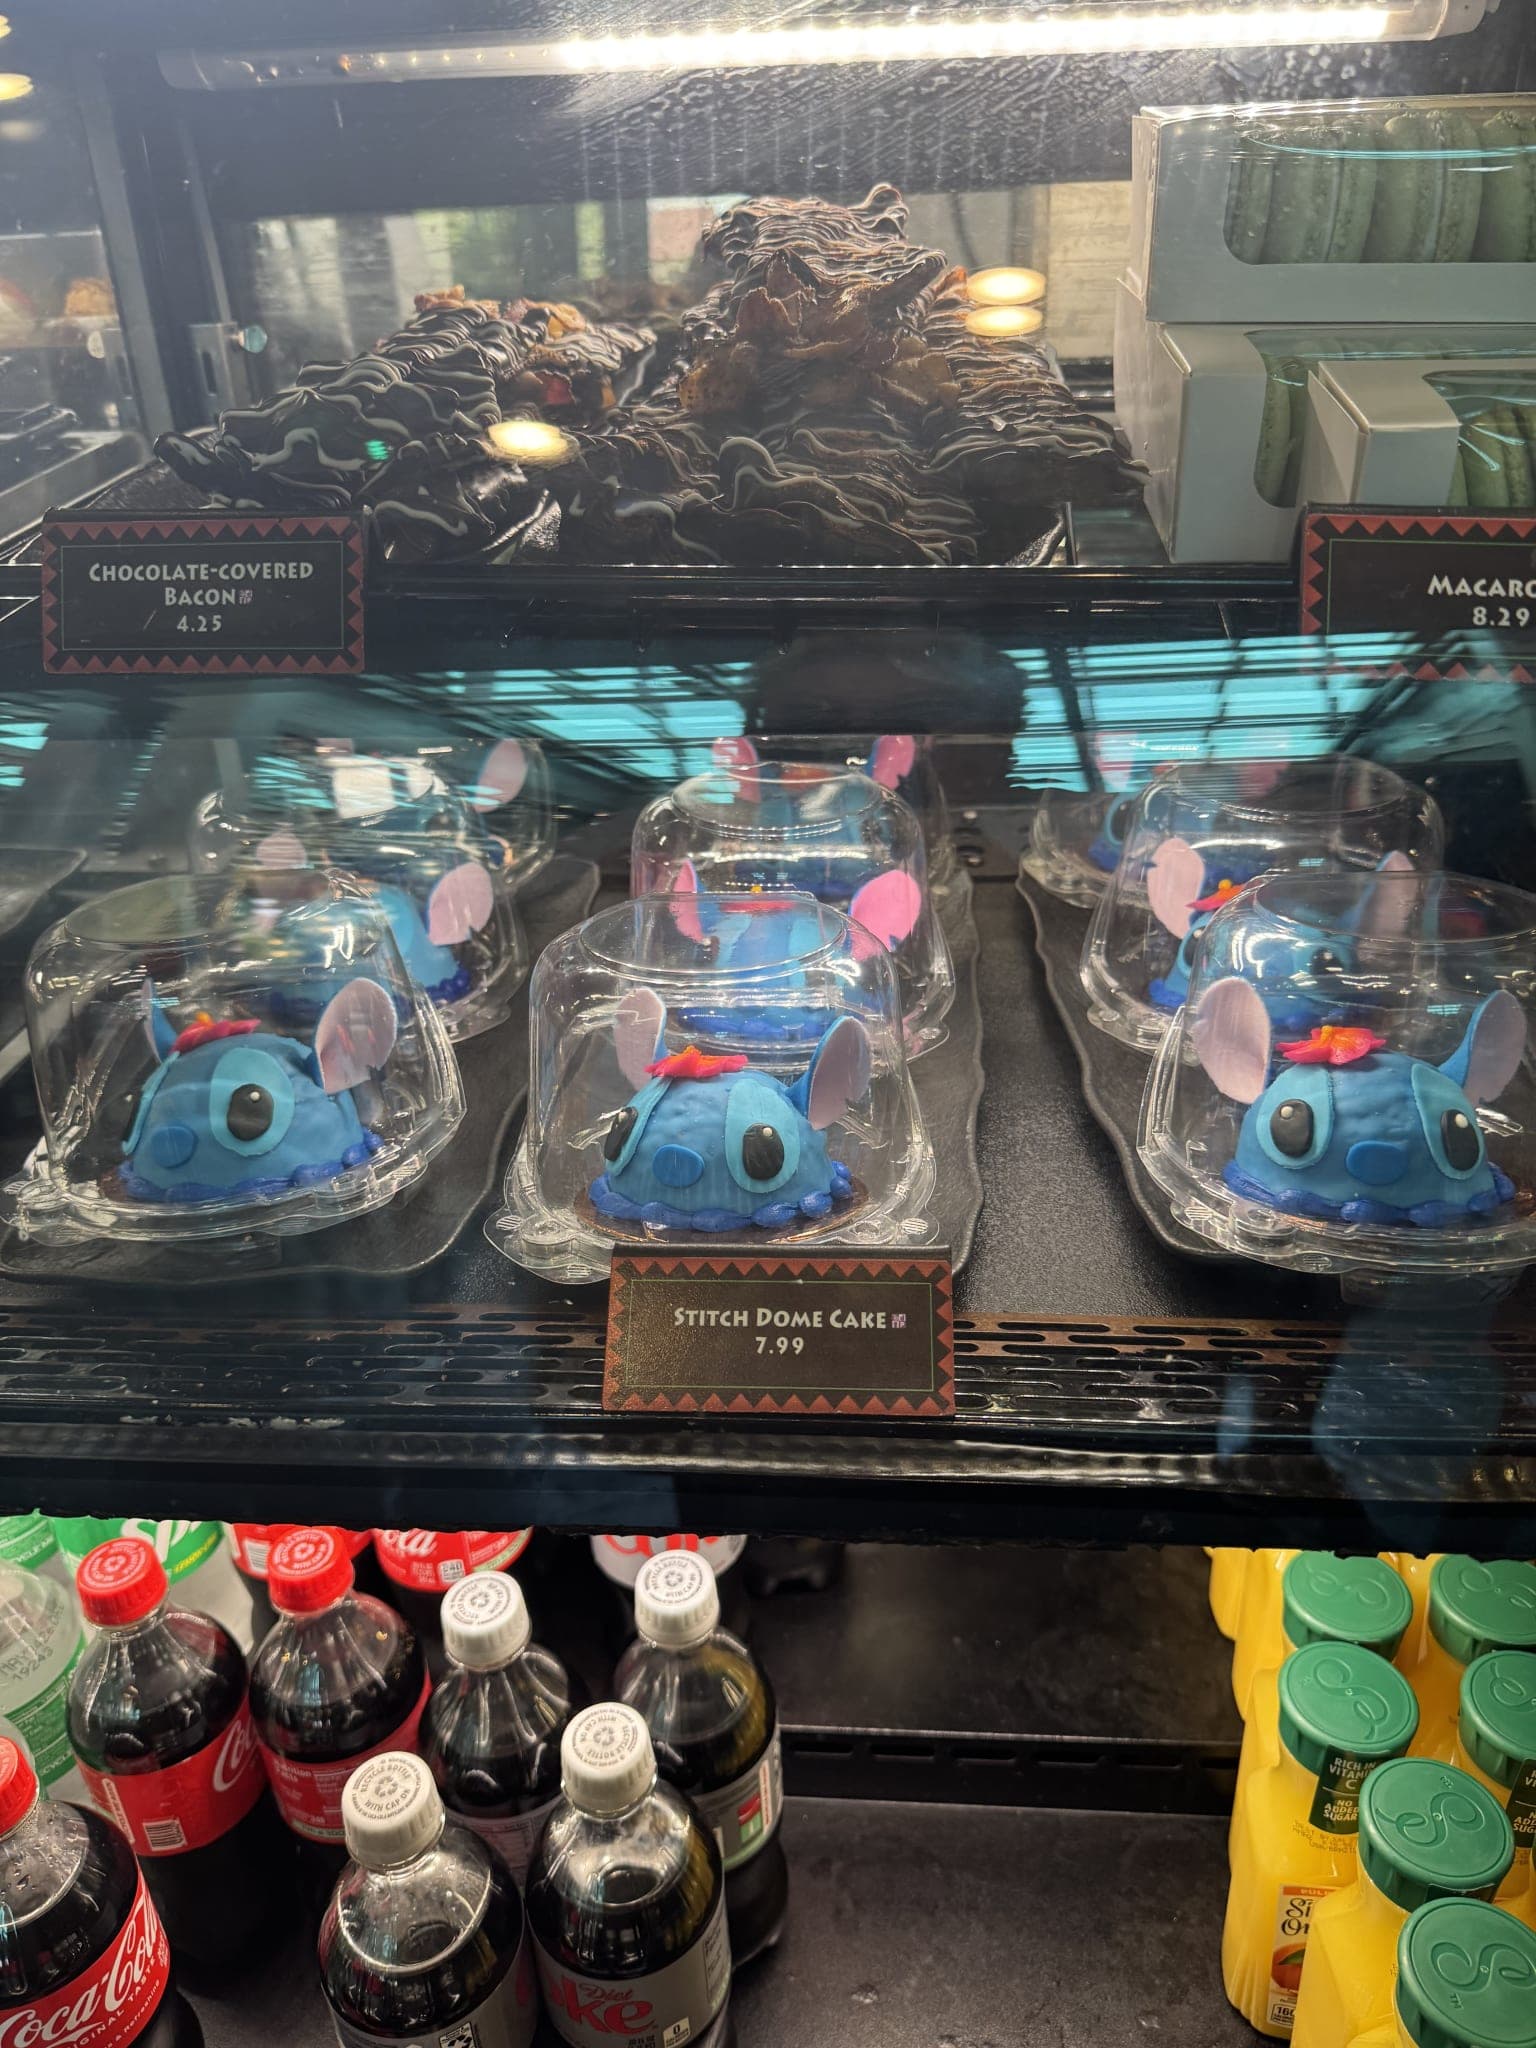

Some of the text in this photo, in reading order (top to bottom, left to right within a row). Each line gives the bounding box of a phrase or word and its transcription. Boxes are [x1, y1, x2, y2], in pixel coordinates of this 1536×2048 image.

[89, 562, 313, 583] CHOCOLATE-COVERED
[165, 587, 236, 607] BACON
[177, 615, 223, 633] 4.25
[1472, 606, 1531, 628] 8.29
[674, 1307, 887, 1330] STITCH DOME CAKE
[755, 1336, 805, 1356] 7.99
[1329, 1763, 1369, 1780] VITAMI
[1334, 1757, 1361, 1770] RICH
[1345, 1779, 1358, 1790] C
[1337, 1799, 1353, 1807] NO
[1323, 1809, 1358, 1822] SUGAR
[127, 1957, 156, 2003] TASTE
[579, 1983, 633, 2001] Diet
